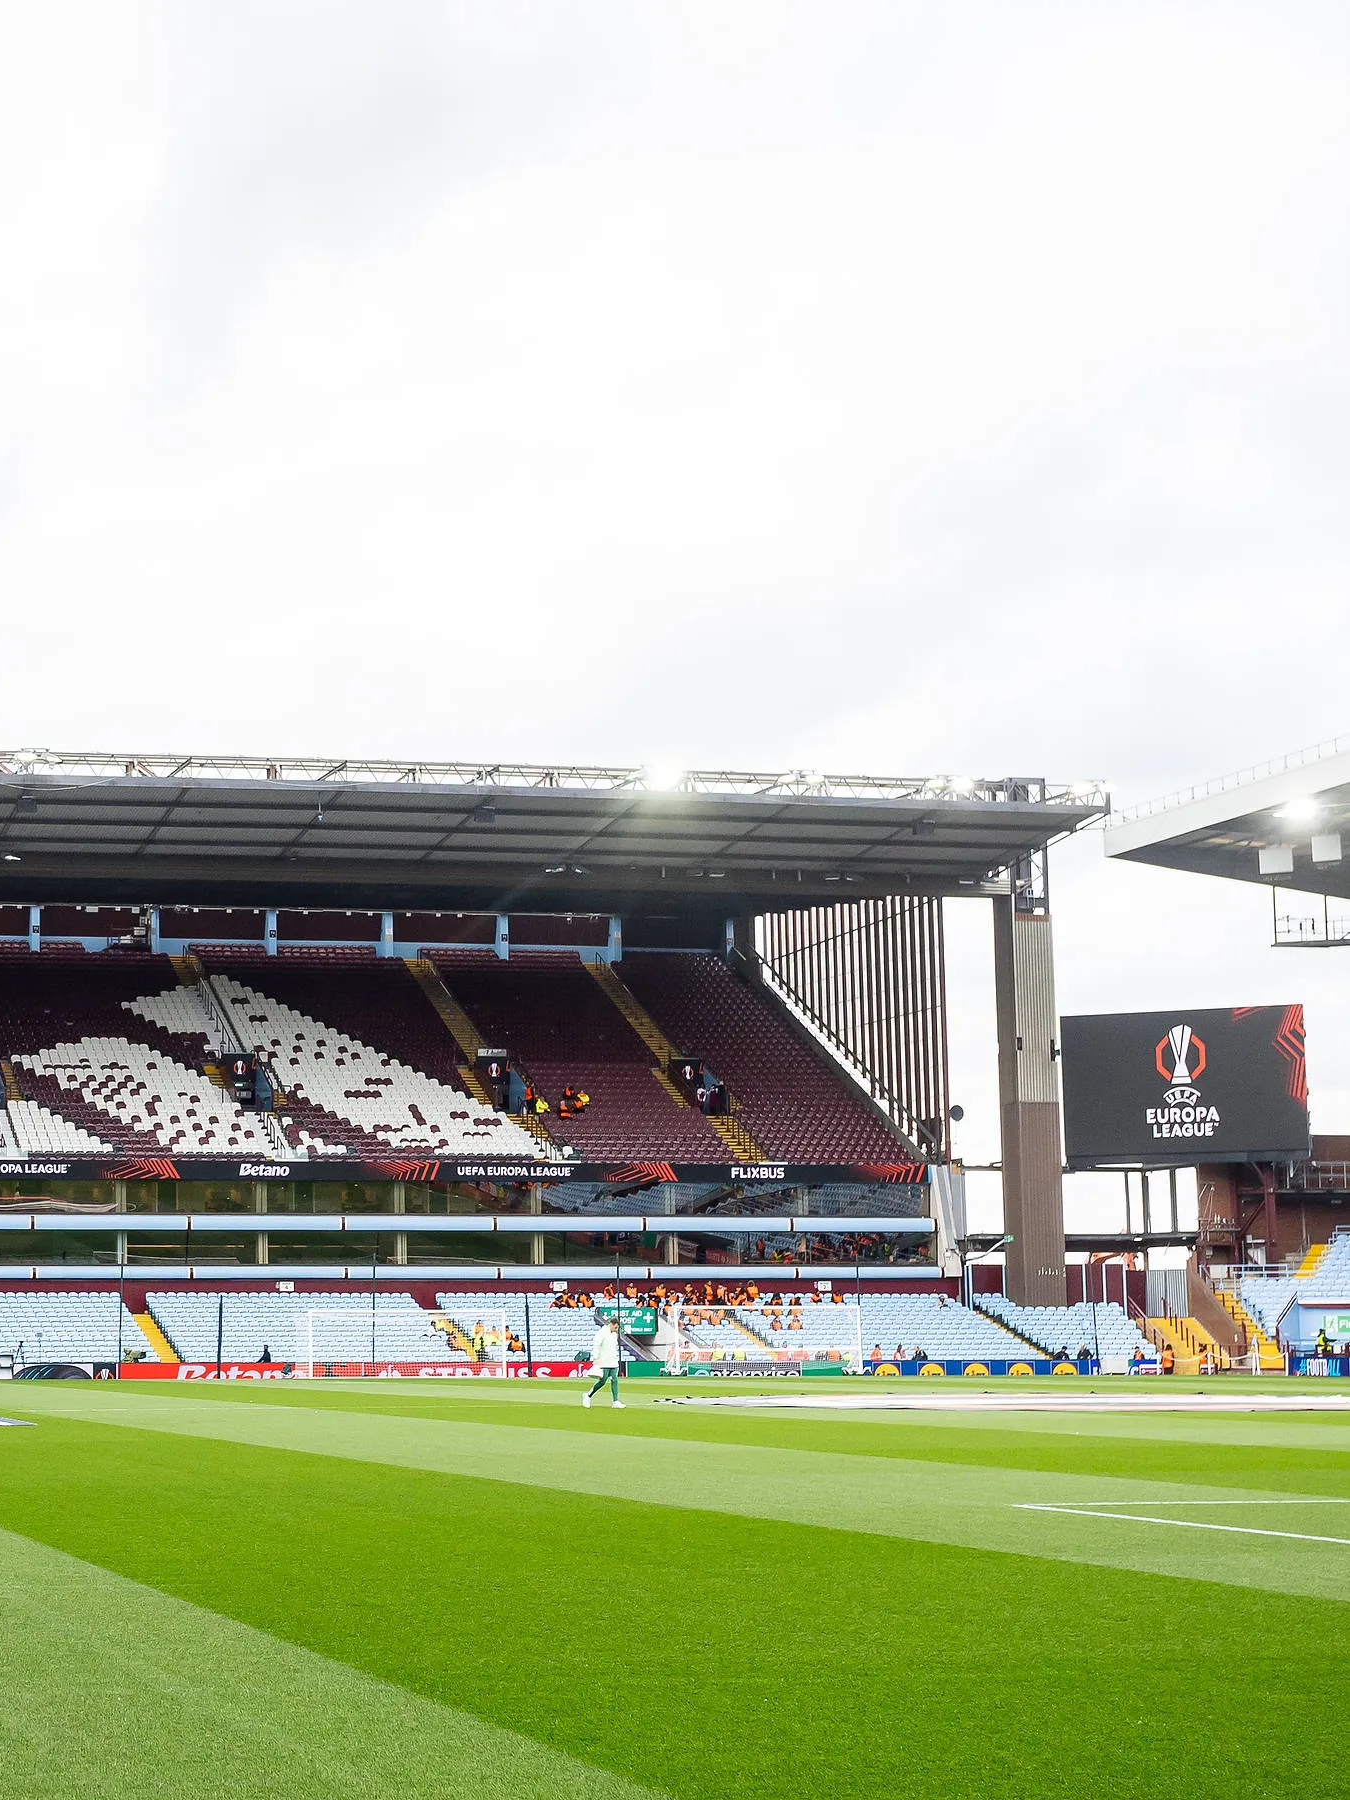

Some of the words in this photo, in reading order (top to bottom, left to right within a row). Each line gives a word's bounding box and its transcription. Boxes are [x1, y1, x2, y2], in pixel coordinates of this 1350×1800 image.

[1164, 1089, 1198, 1104] UEFA
[1146, 1106, 1220, 1124] EUROPA
[239, 1163, 290, 1177] Betano
[457, 1166, 485, 1176] UEFA
[487, 1166, 530, 1176] EUROPA
[1299, 1358, 1341, 1377] #FOOTBALL
